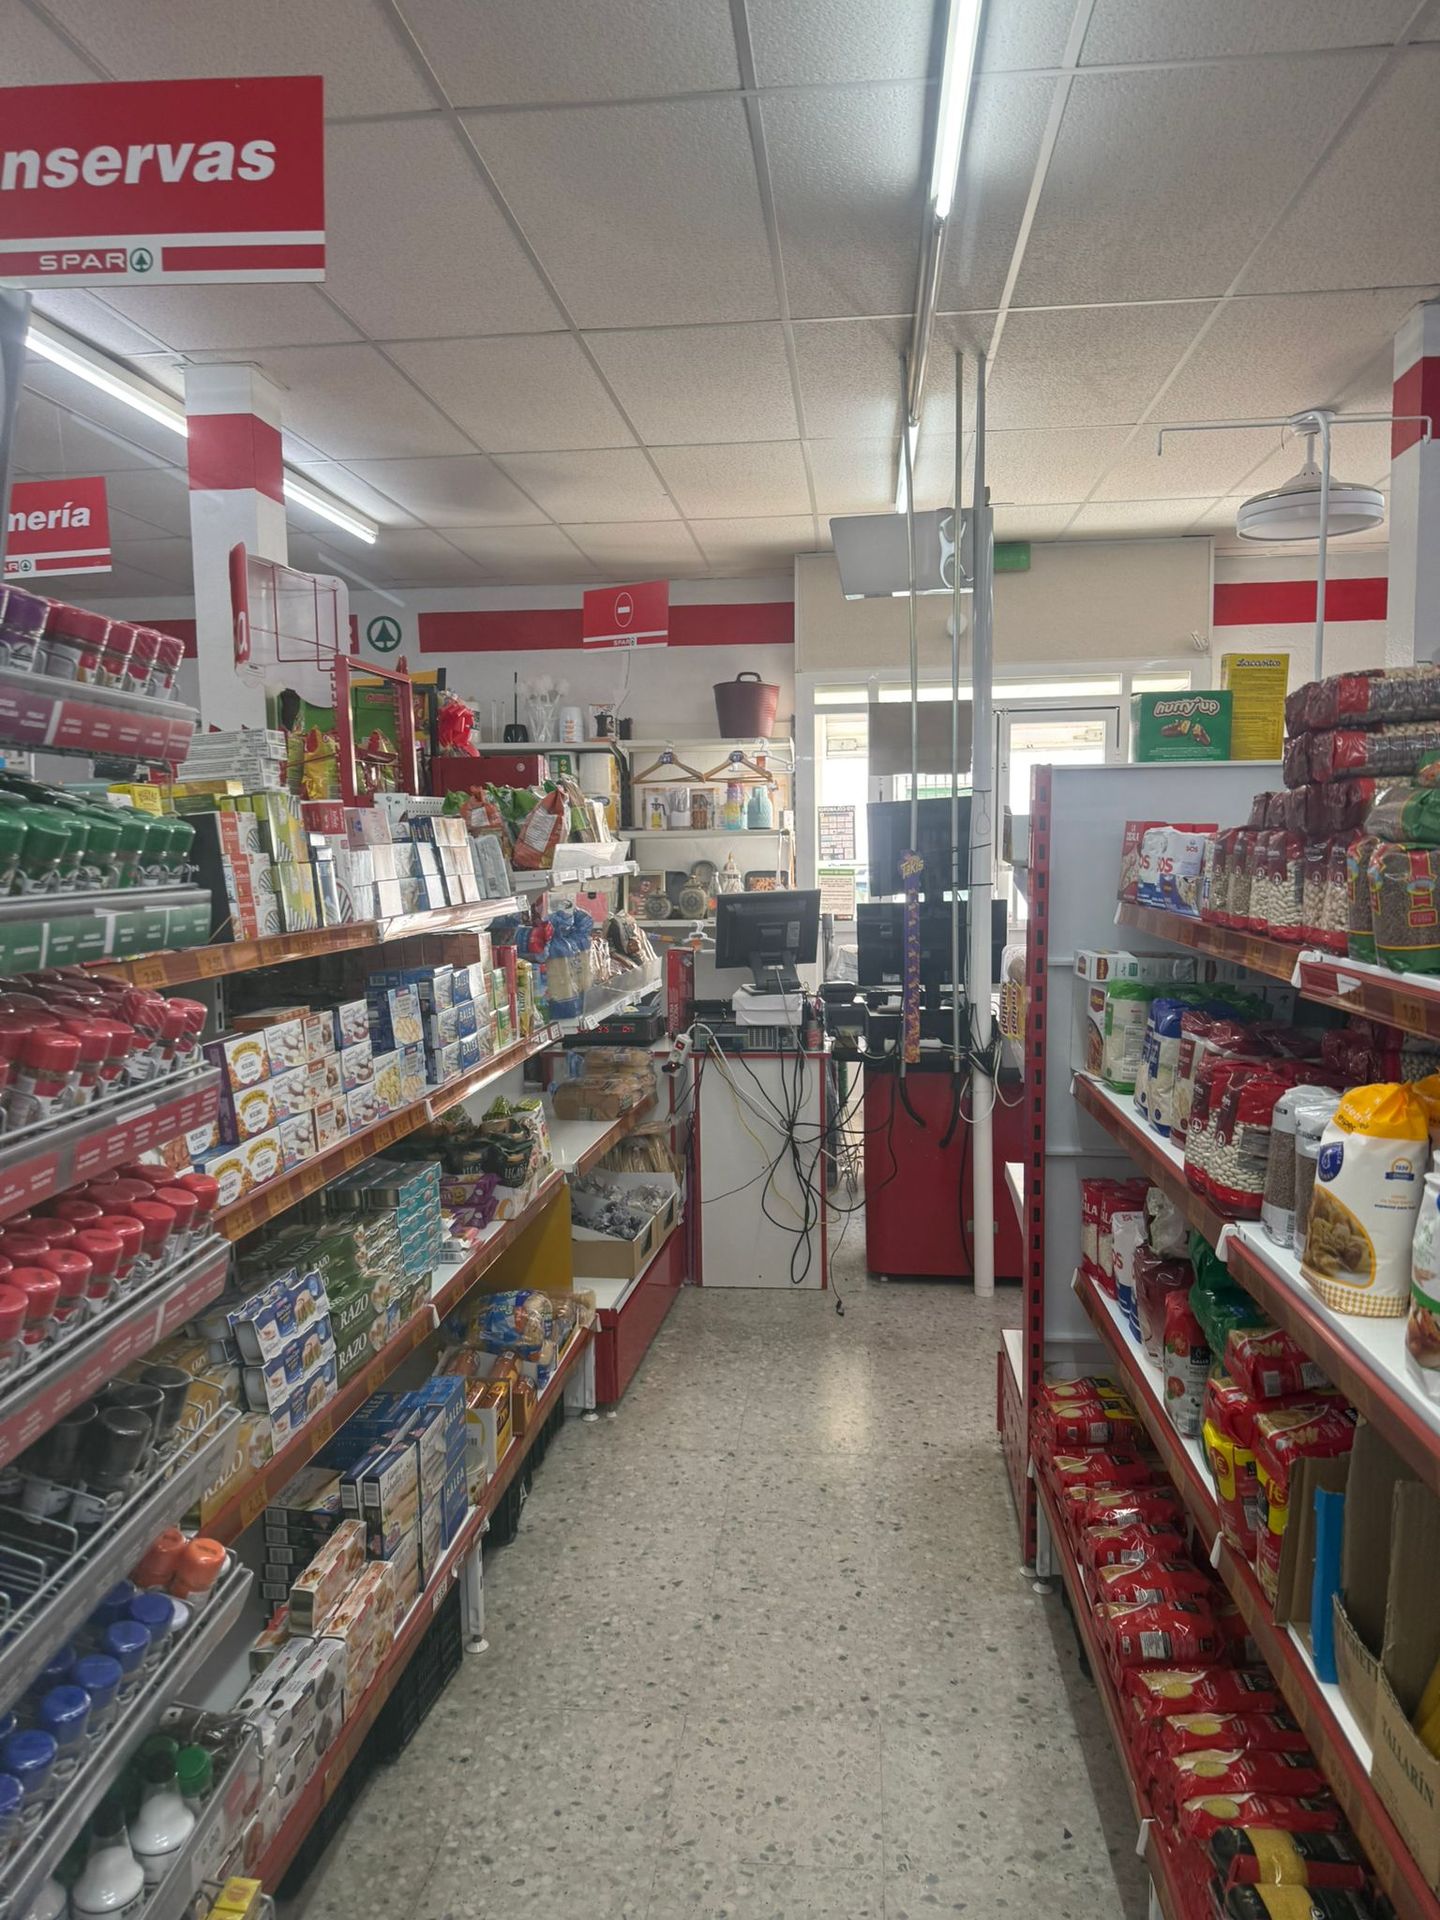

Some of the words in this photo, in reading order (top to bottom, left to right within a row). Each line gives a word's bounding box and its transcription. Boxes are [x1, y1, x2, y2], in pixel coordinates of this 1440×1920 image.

[0, 139, 277, 191] nservas
[39, 252, 126, 271] SPAR
[340, 1293, 369, 1329] RAZO
[339, 1332, 367, 1370] RAZO
